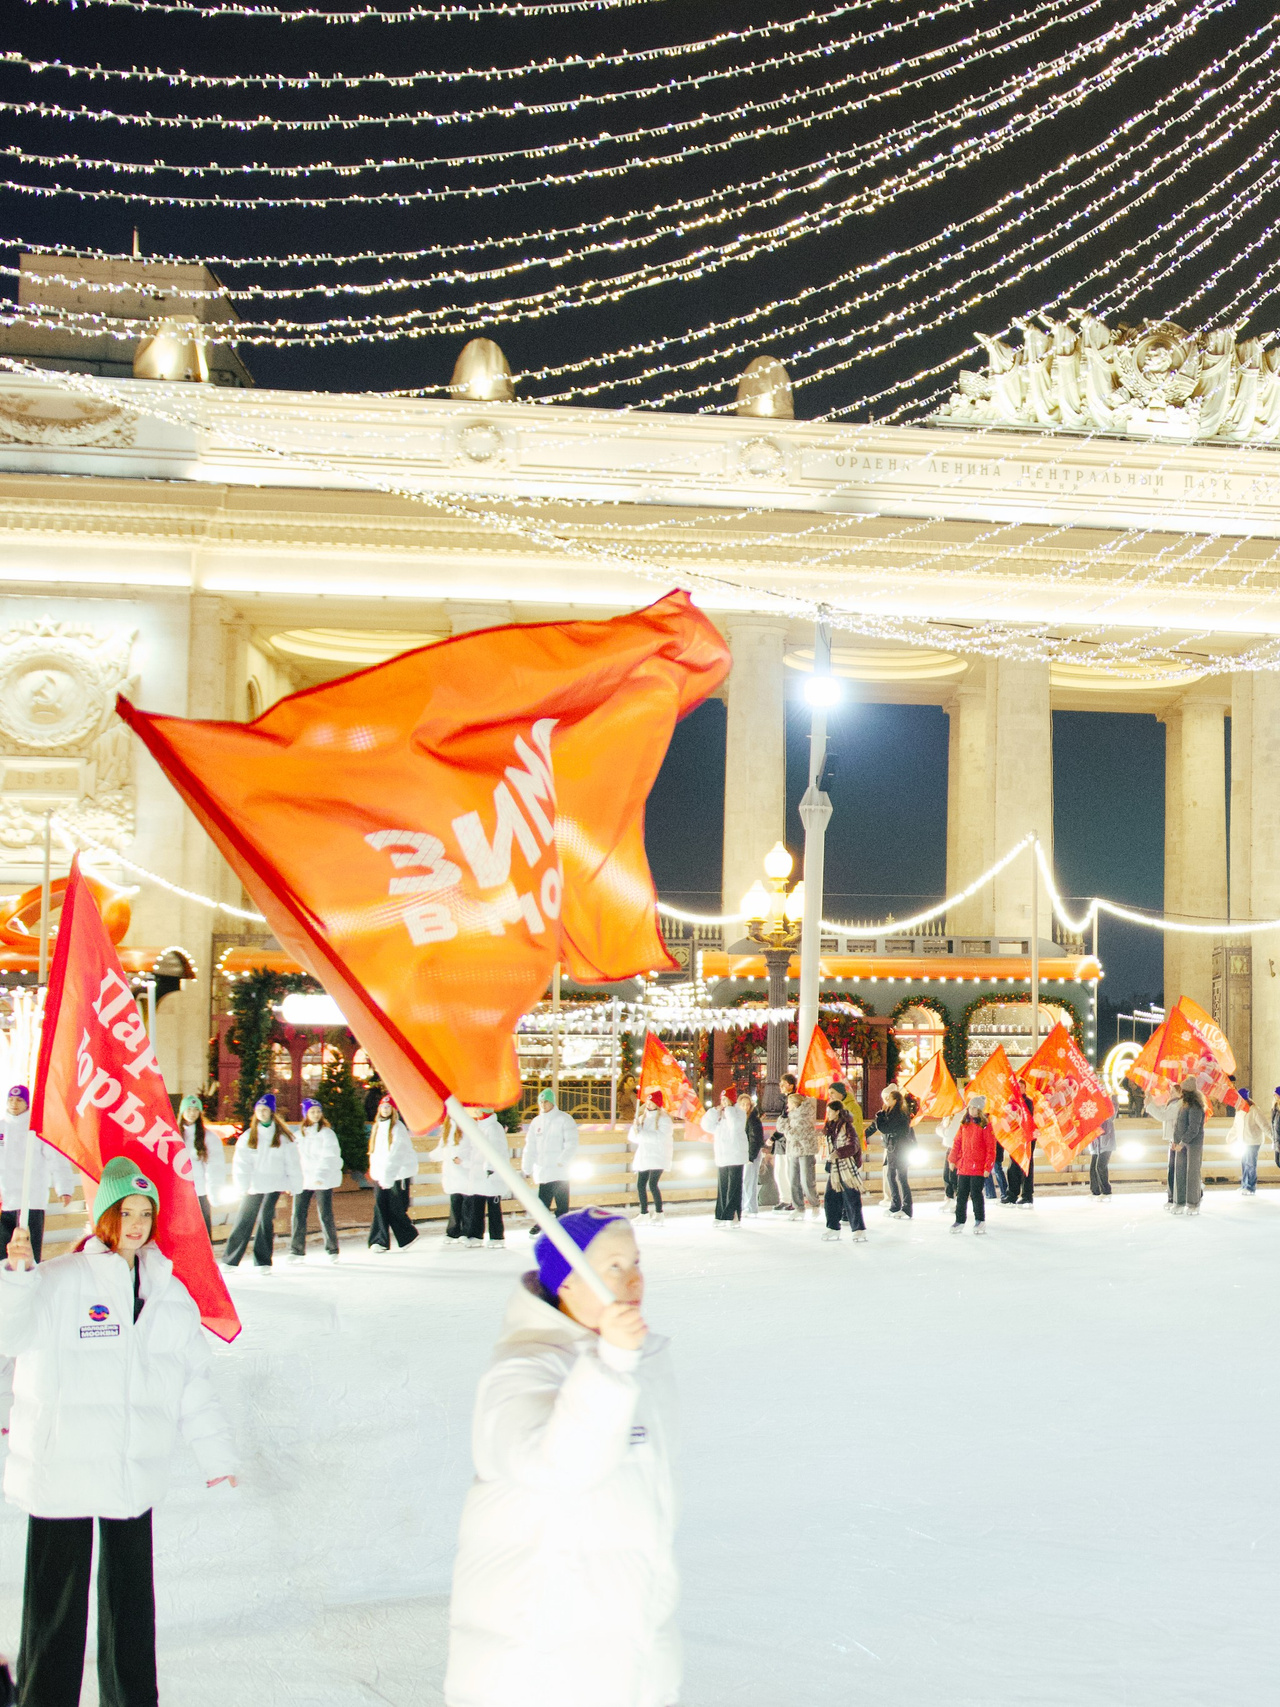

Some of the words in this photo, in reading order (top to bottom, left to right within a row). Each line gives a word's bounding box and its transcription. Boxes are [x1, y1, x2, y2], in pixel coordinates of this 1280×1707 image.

[835, 455, 910, 471] ОРДЕНА
[928, 459, 1001, 477] ЛЕНИНА
[1184, 475, 1232, 491] ПАРК
[1016, 480, 1079, 491] ИМЕНИ
[402, 902, 459, 947] В
